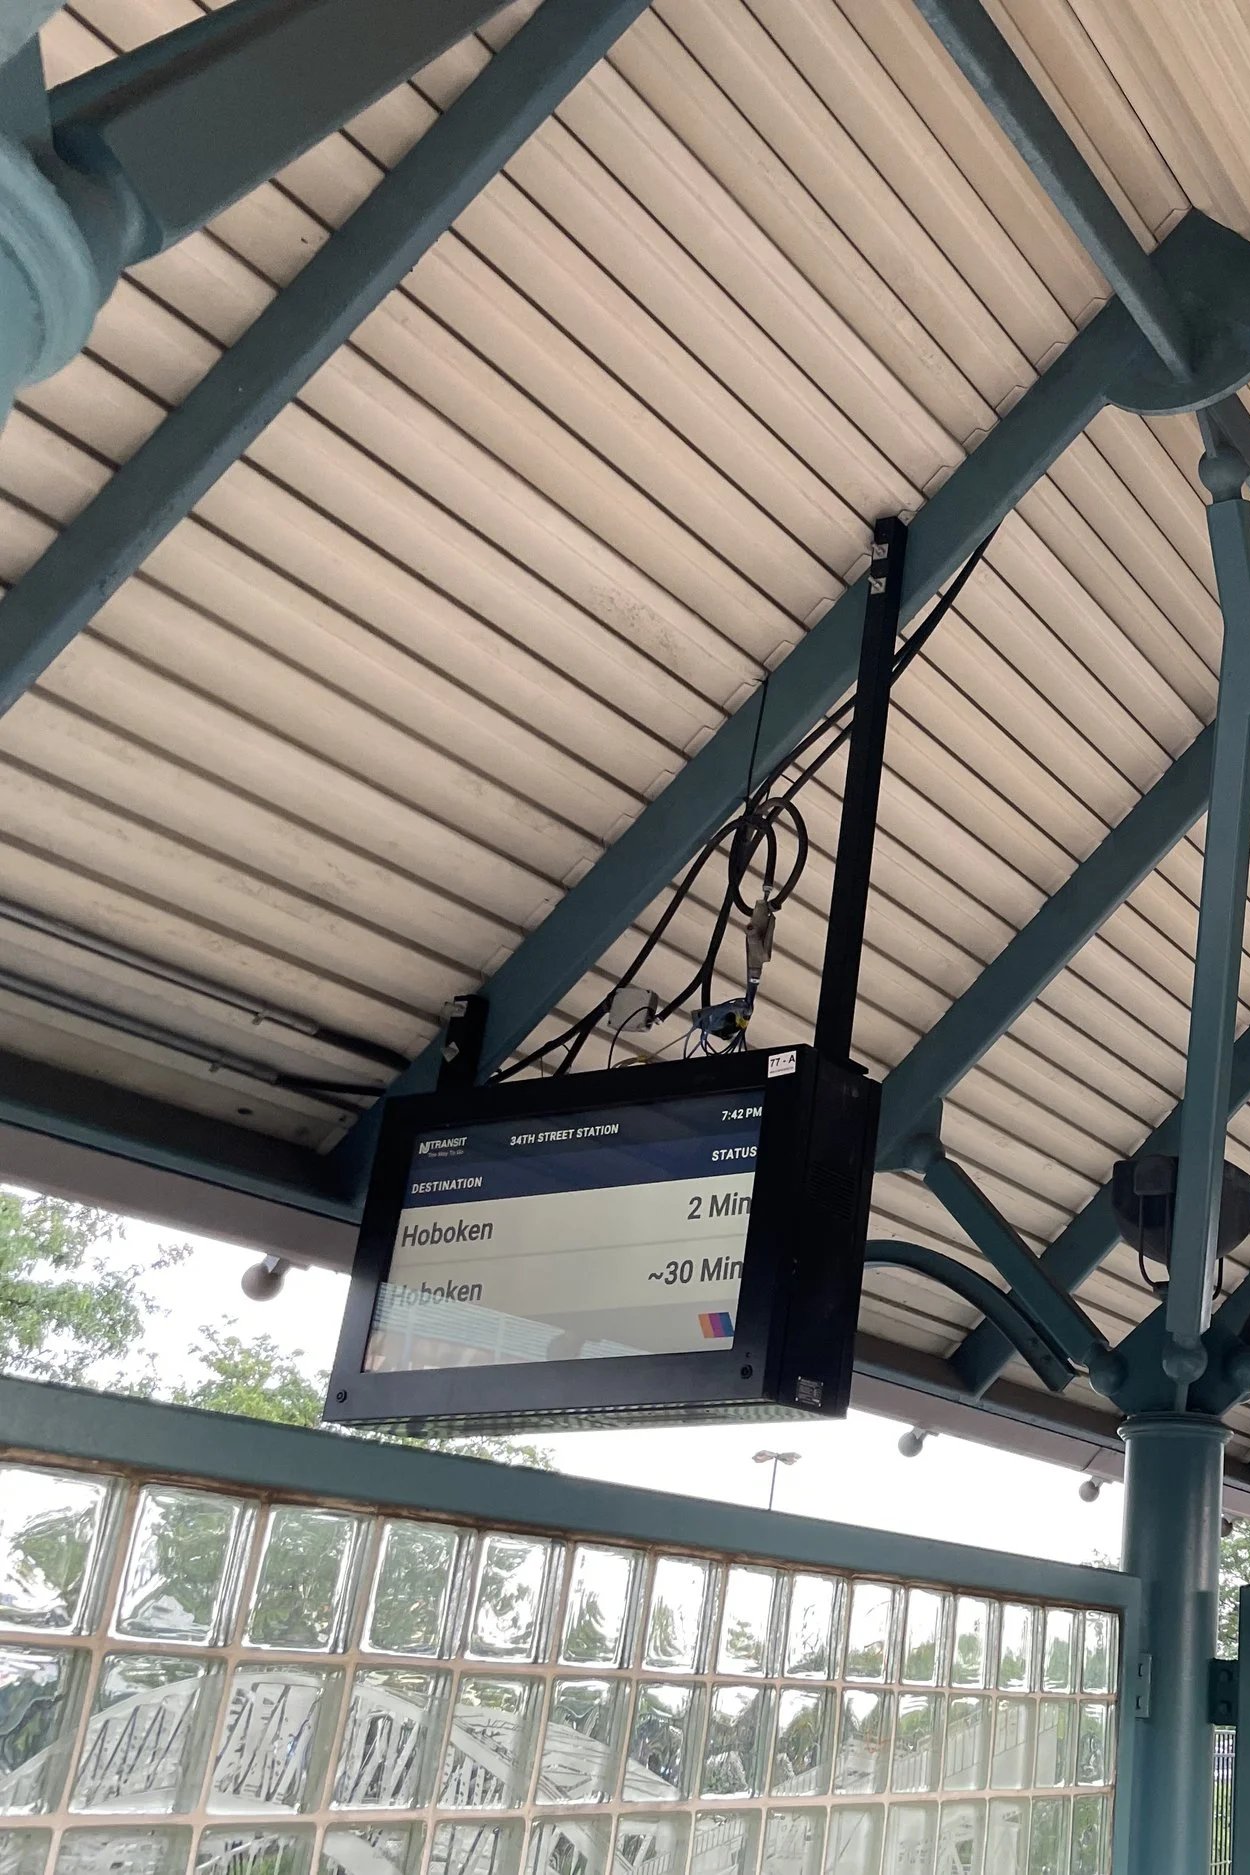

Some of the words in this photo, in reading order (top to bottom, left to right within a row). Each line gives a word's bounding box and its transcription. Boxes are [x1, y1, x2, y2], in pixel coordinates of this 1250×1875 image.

[770, 1058, 781, 1068] 77
[788, 1055, 796, 1064] A
[721, 1108, 744, 1121] 7:42
[745, 1106, 763, 1118] PM
[510, 1134, 536, 1146] 34TH
[537, 1129, 575, 1143] STREET
[576, 1123, 619, 1138] STATION
[711, 1146, 758, 1161] STATUS
[411, 1176, 483, 1194] DESTINATION
[687, 1196, 702, 1220] 2
[708, 1191, 752, 1218] Min
[401, 1219, 493, 1248] Hoboken
[648, 1259, 694, 1285] ~30
[700, 1256, 744, 1282] Min
[391, 1279, 483, 1307] Hoboken
